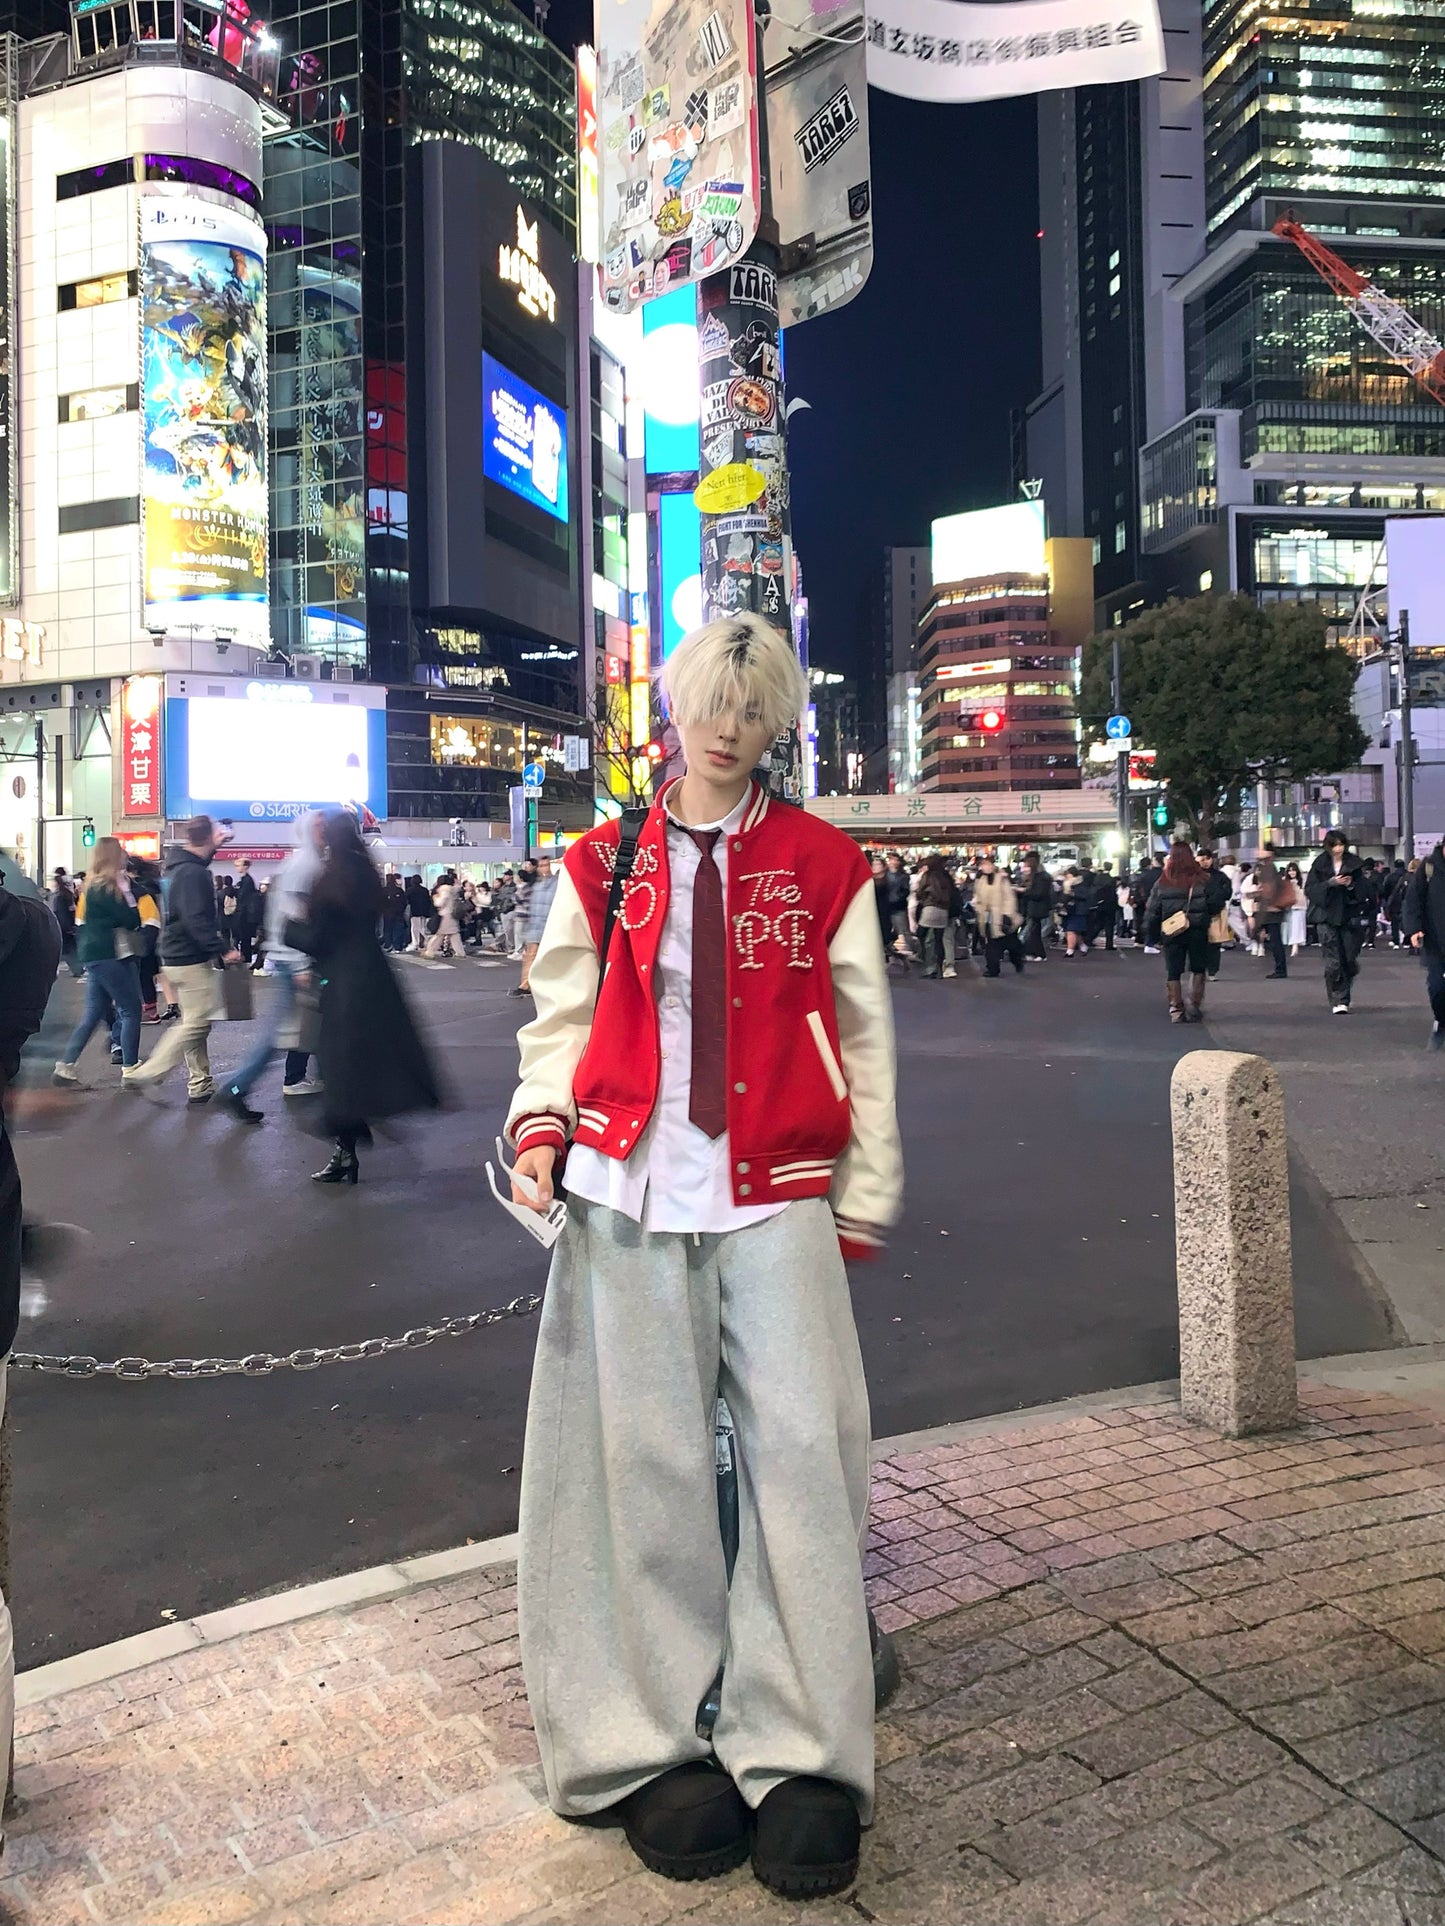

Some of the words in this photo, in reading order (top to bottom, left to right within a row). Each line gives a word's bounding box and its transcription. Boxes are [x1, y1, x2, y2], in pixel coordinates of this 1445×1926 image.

[172, 508, 234, 526] MONSTER
[851, 802, 870, 815] JR
[907, 794, 1041, 816] 渋谷駅
